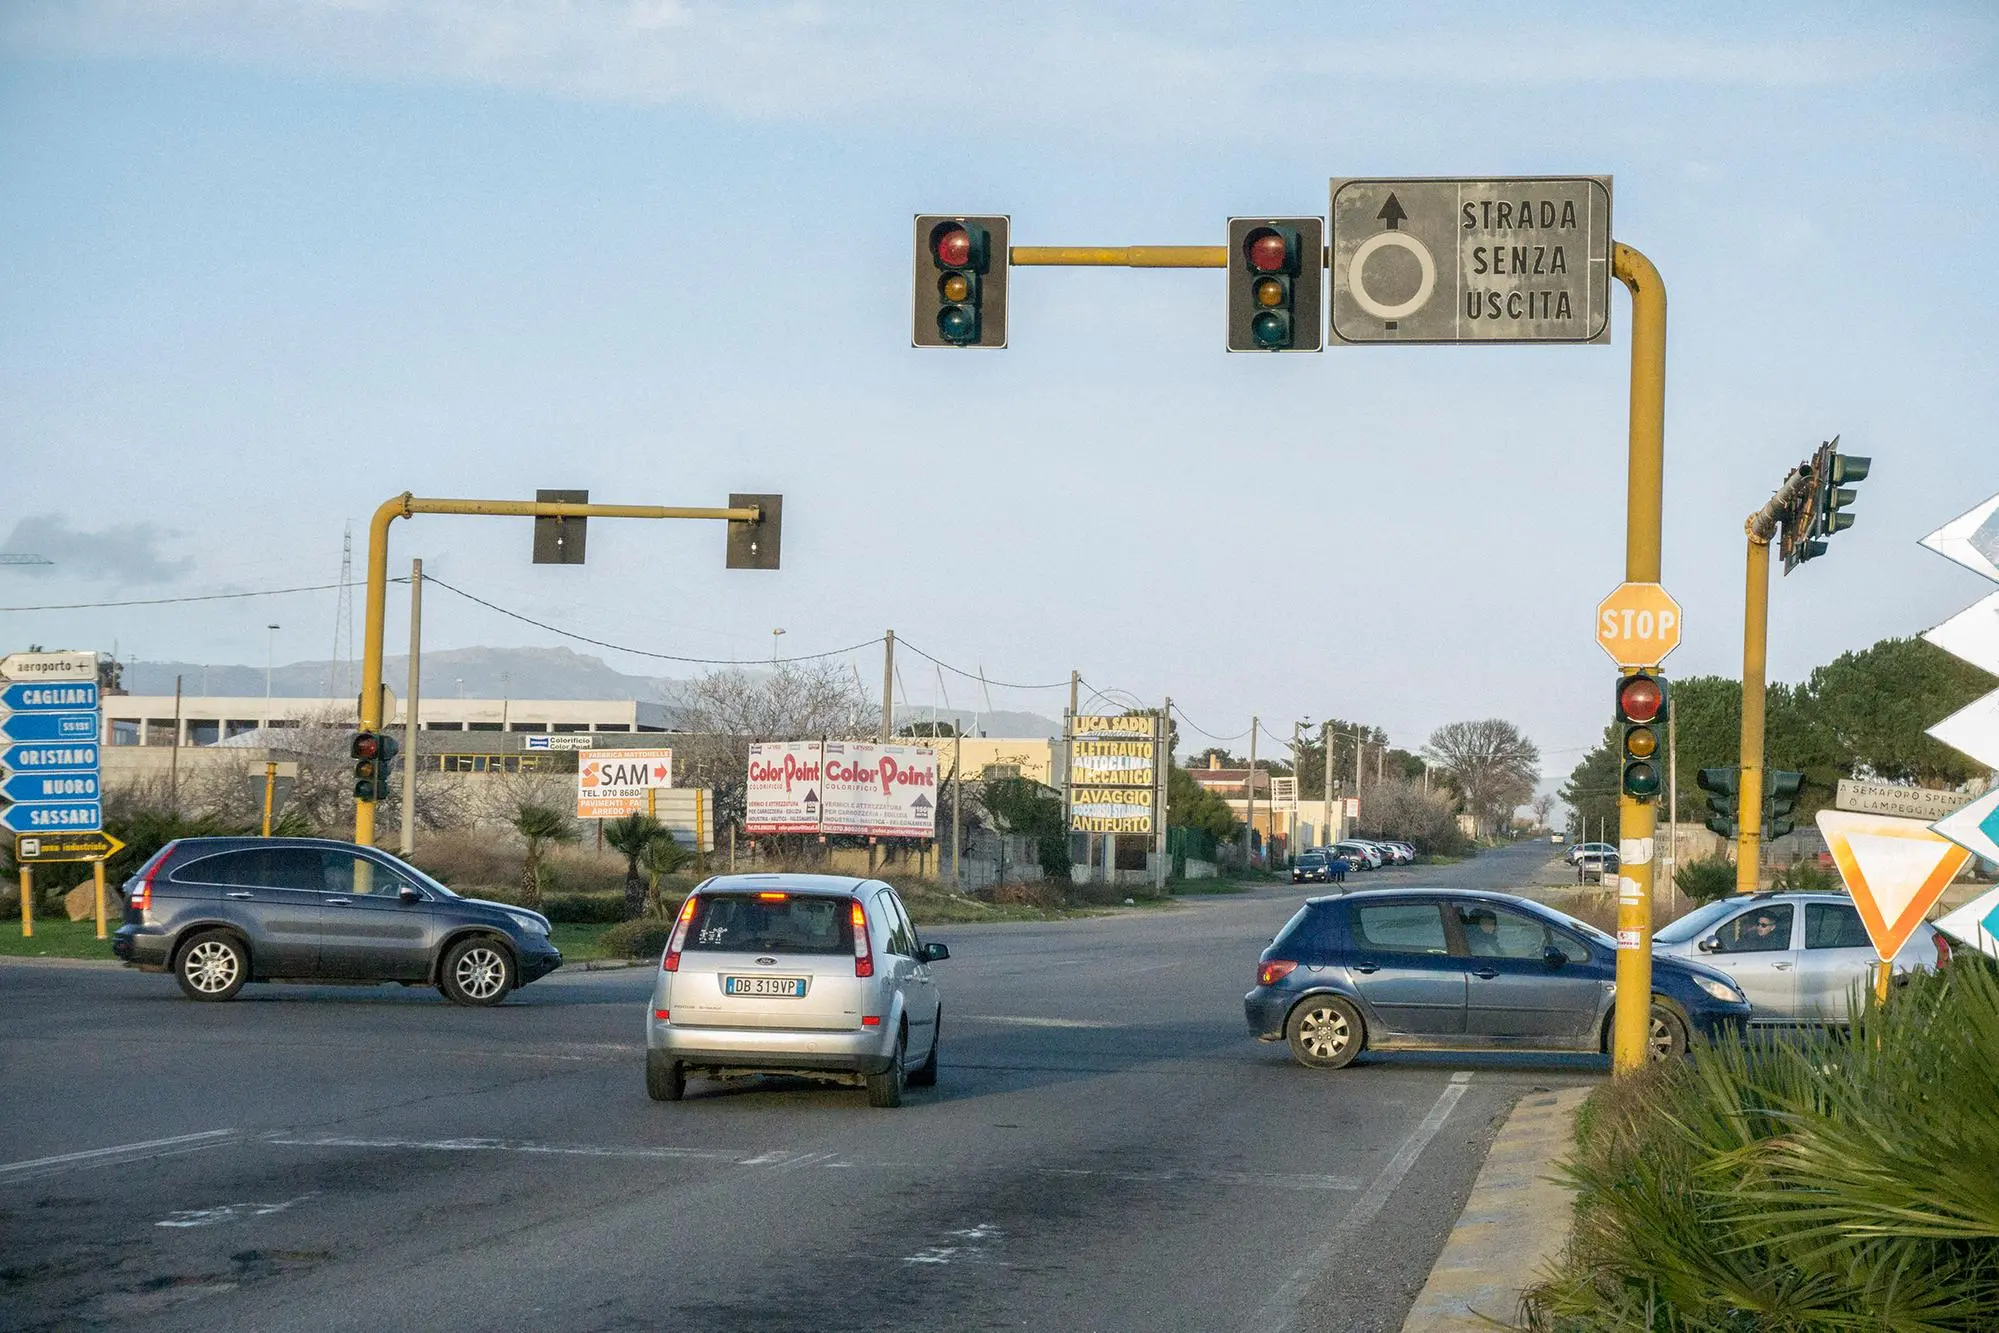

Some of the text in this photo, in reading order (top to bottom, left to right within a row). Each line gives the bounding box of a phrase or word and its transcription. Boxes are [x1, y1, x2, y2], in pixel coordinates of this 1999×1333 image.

[1462, 200, 1577, 230] STRADA
[1472, 246, 1567, 275] SENZA
[1466, 291, 1572, 320] USCITA
[1602, 609, 1675, 640] STOP
[17, 660, 72, 674] aeroporto
[22, 688, 94, 705] CAGLIARI
[1073, 716, 1154, 737] LUCA SADDI
[19, 749, 95, 766] ORISTANO
[1073, 741, 1152, 759] ELETTRAUTO
[600, 764, 648, 786] SAM
[1072, 769, 1152, 785] MECCANICO
[42, 779, 95, 795] NUORO
[603, 789, 618, 797] 070
[620, 789, 641, 797] 8680
[825, 783, 878, 792] COLORIFICIO
[1840, 784, 1847, 792] A
[1852, 785, 1920, 801] SEMAFORO
[1072, 789, 1151, 806] LAVAGGIO
[1850, 798, 1857, 806] O
[30, 808, 97, 826] SASSARI
[1072, 815, 1151, 832] ANTIFURTO
[736, 979, 751, 992] DB
[756, 981, 795, 994] 319VP
